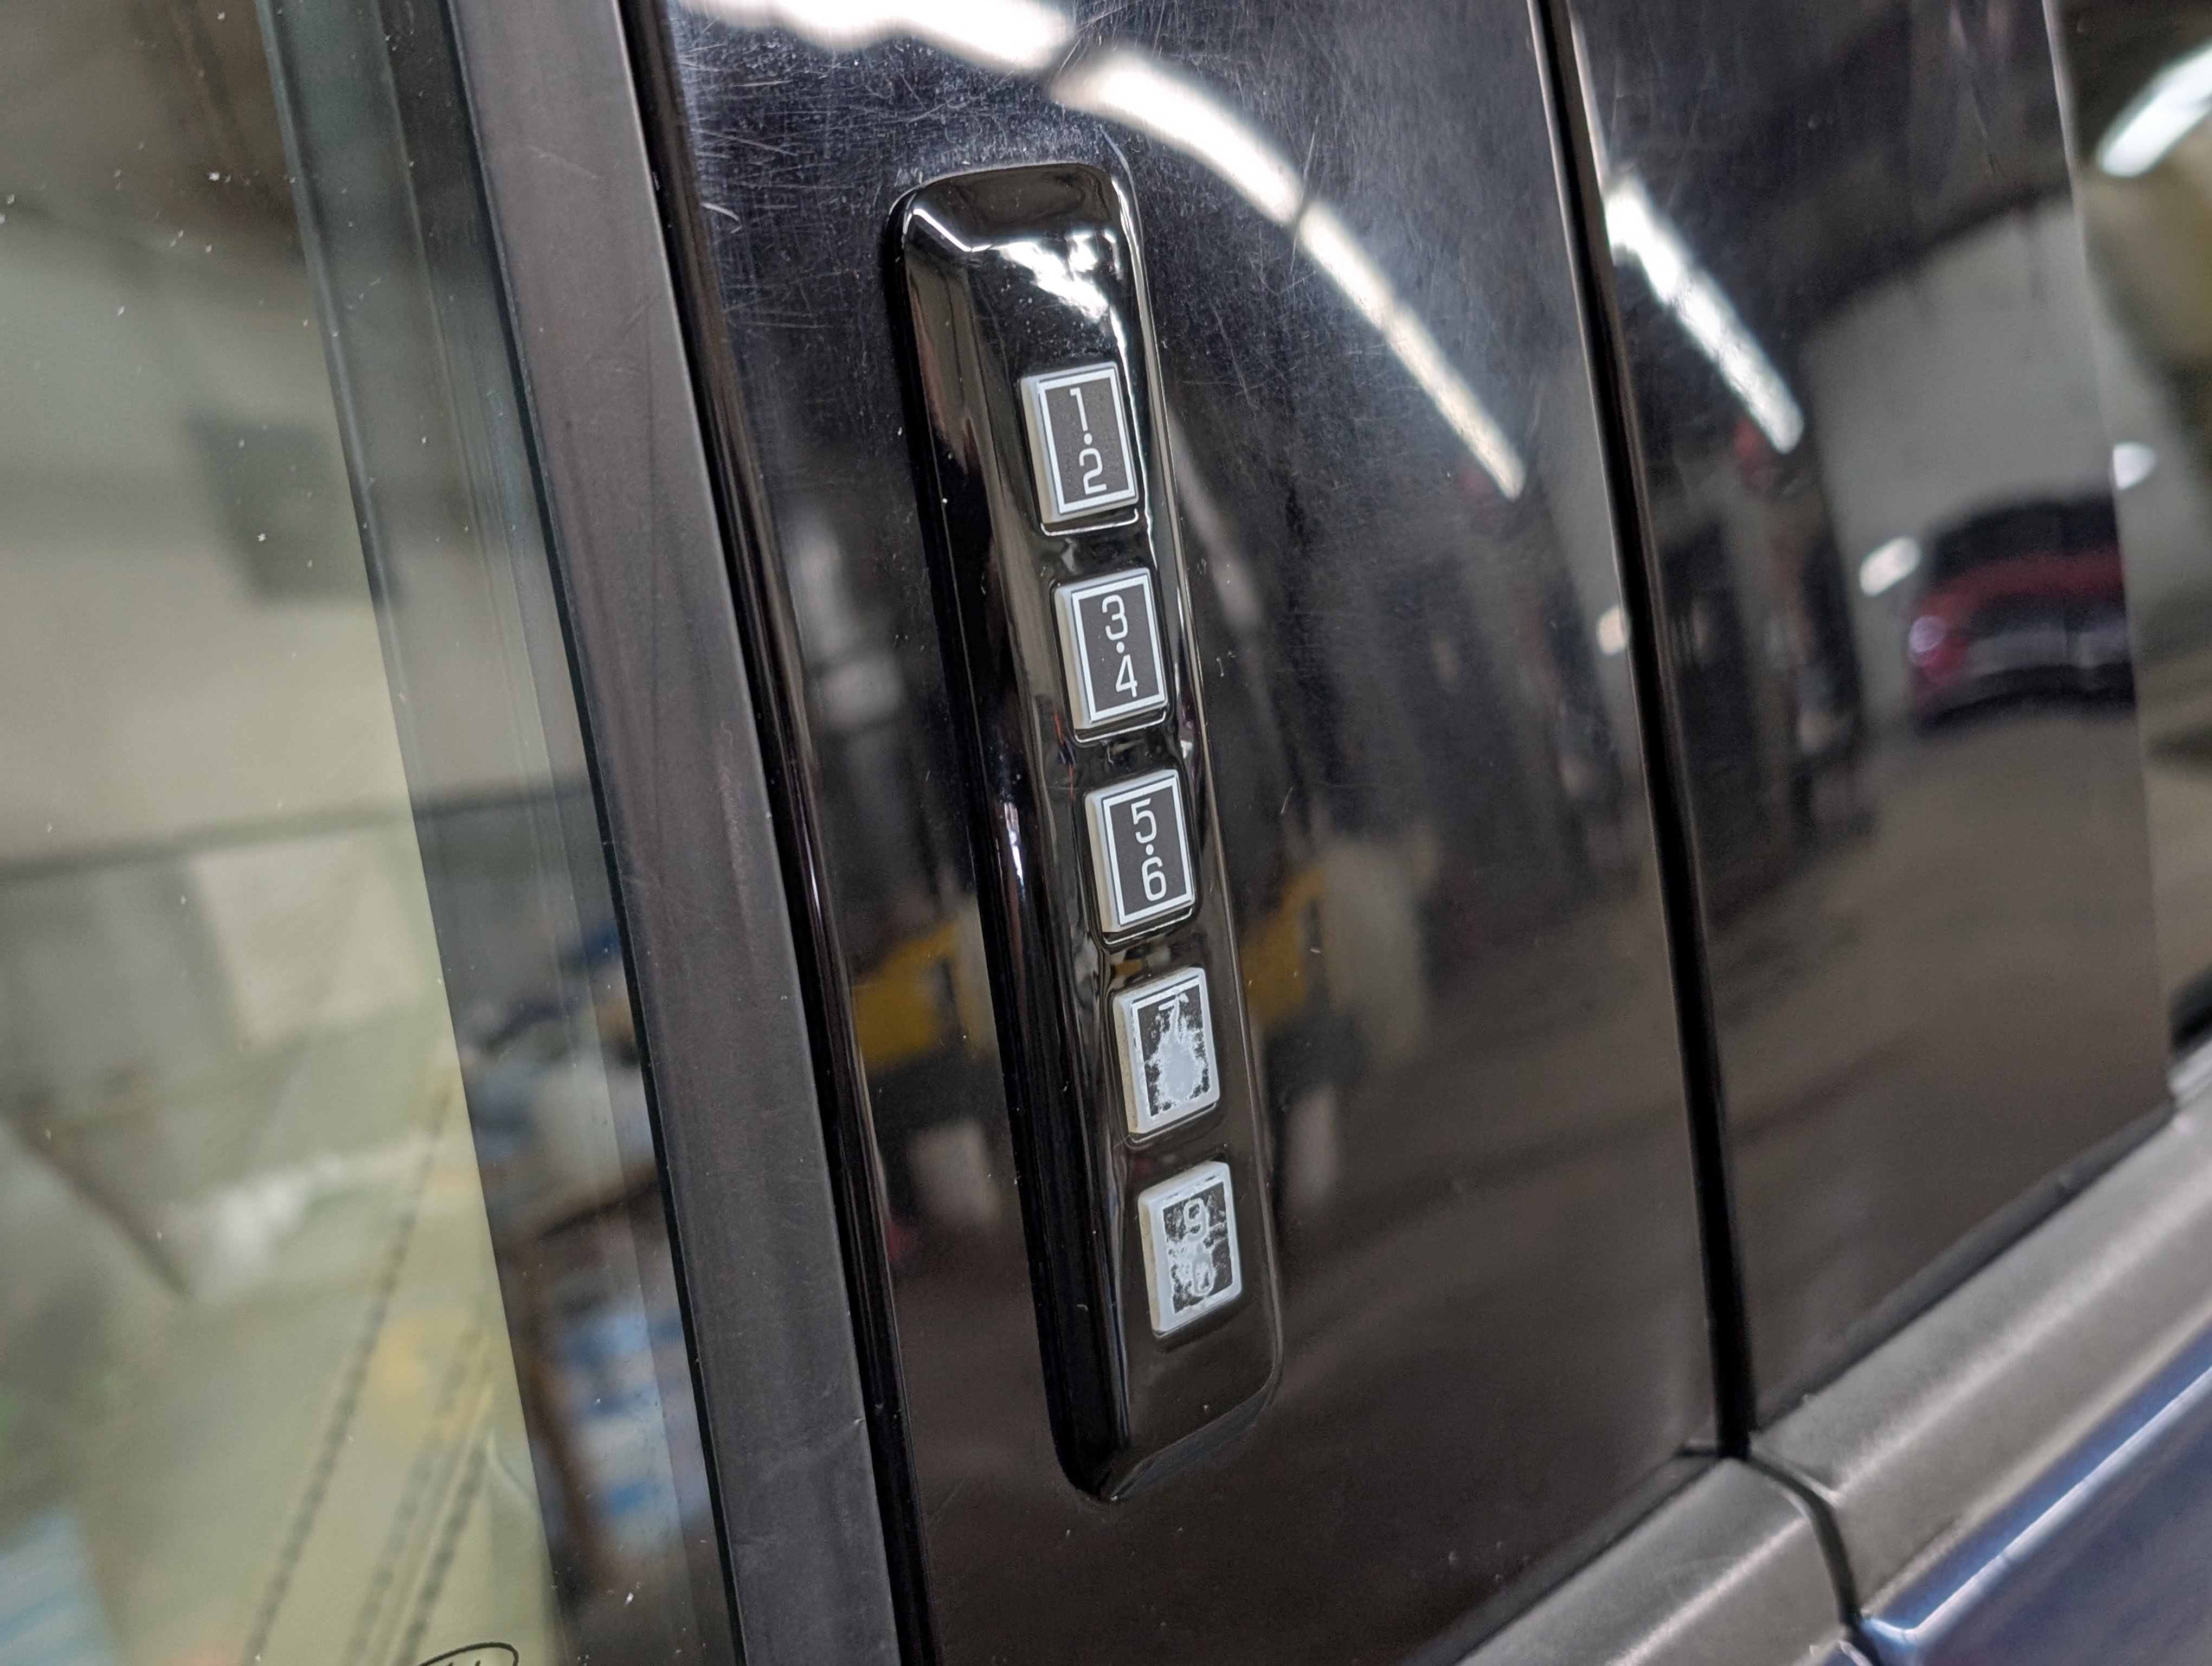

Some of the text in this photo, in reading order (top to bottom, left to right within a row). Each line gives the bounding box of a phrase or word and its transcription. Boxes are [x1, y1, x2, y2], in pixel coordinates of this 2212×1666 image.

[1070, 388, 1088, 431] 1
[1078, 447, 1107, 495] 2
[1102, 594, 1128, 640] 3
[1115, 653, 1138, 698] 4
[1130, 797, 1158, 844] 5
[1141, 856, 1167, 902] 6
[1183, 1197, 1209, 1242] 9
